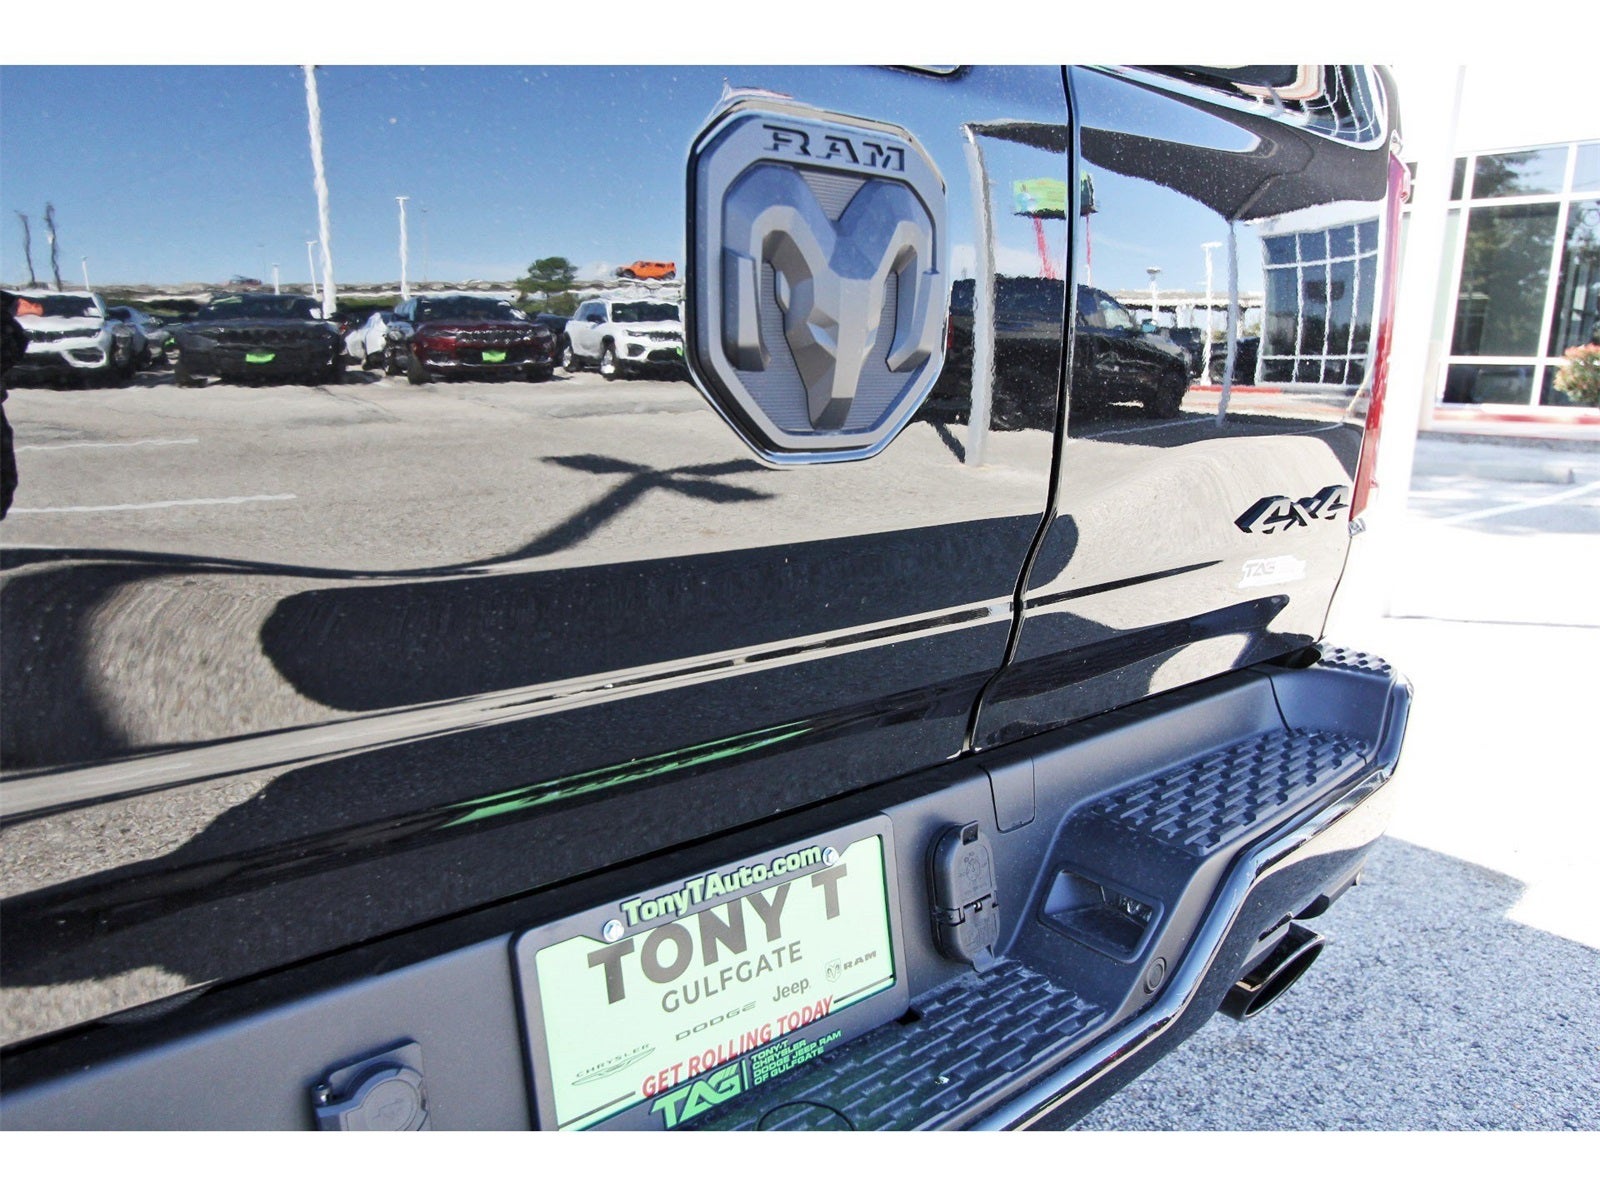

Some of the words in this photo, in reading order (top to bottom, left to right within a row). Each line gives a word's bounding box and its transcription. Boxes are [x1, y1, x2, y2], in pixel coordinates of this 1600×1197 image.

[763, 124, 905, 172] RAM
[620, 845, 822, 926] TonyTAuto.com
[587, 883, 791, 1005] TONY
[811, 863, 847, 920] T
[661, 940, 803, 1013] GULFGATE
[844, 951, 877, 970] RAM
[772, 978, 809, 1002] Jeep
[675, 1001, 756, 1041] DODGE
[576, 1043, 650, 1077] CHRYSLER
[642, 1062, 683, 1098] GET
[688, 1023, 771, 1078] ROLLING
[777, 995, 833, 1036] TODAY
[752, 1039, 807, 1070] CHRYSLER
[753, 1056, 790, 1078] DODGE
[792, 1042, 817, 1060] JEEP
[819, 1030, 842, 1046] RAM
[754, 1074, 769, 1085] OF
[770, 1046, 824, 1077] GULFGATE
[650, 1062, 742, 1129] TAG
